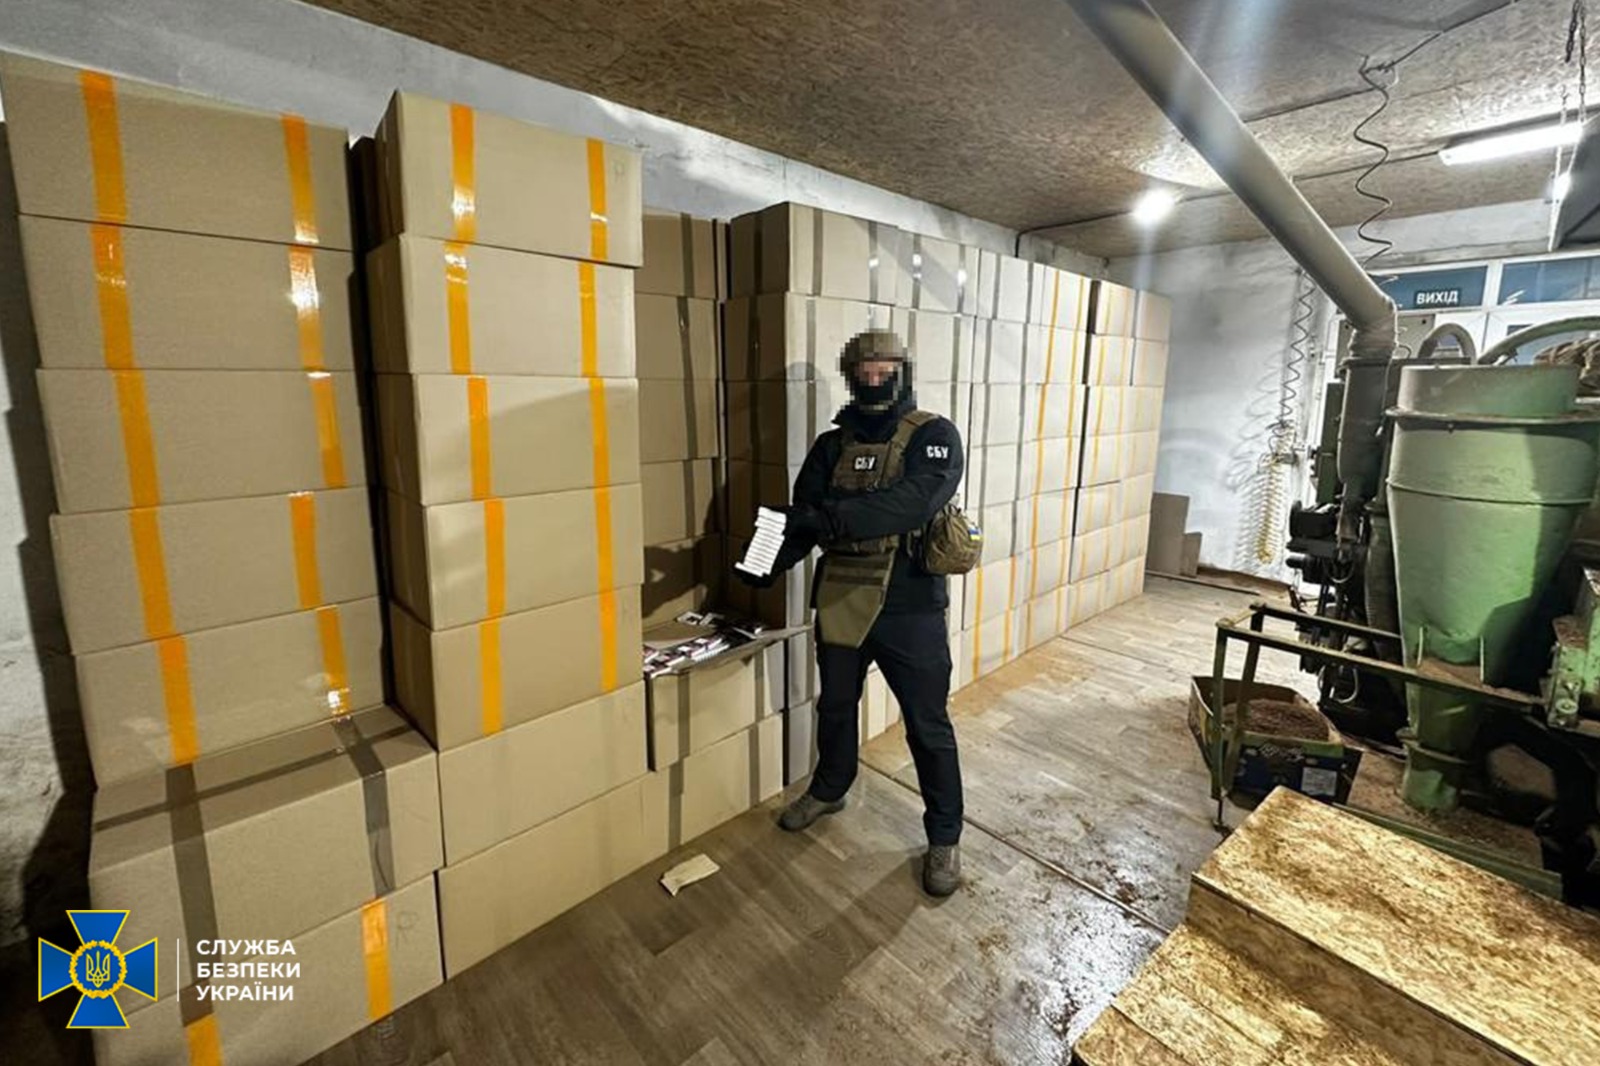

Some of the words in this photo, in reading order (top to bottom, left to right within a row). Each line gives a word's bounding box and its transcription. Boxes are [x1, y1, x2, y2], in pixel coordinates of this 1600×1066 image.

[1416, 290, 1459, 304] ВИХІД
[926, 445, 949, 459] СБУ
[854, 456, 876, 470] СБУ
